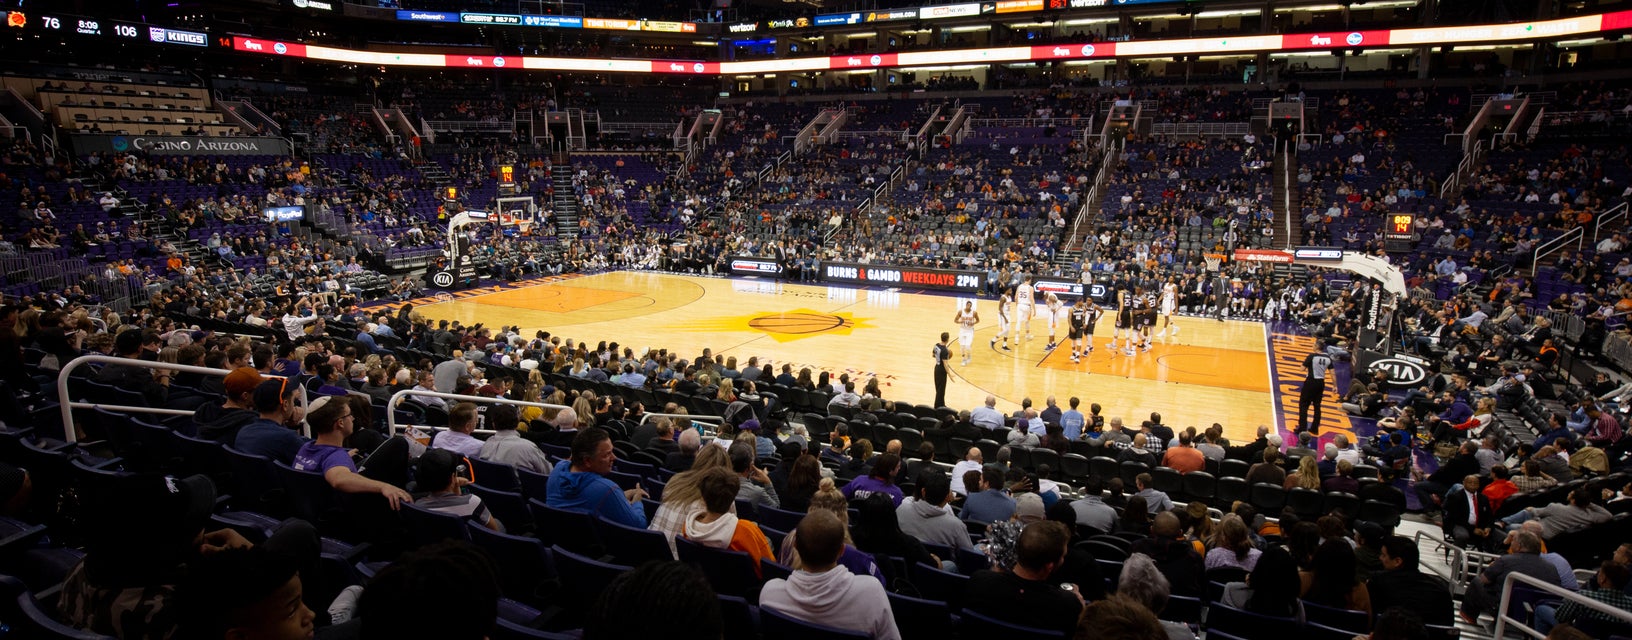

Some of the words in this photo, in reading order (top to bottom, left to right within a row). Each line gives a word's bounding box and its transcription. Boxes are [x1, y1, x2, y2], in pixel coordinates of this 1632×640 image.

[42, 16, 60, 29] 76
[78, 20, 98, 29] 8:09
[114, 25, 137, 37] 106
[729, 23, 755, 33] verizon
[167, 31, 204, 44] KINGS
[219, 37, 230, 47] 14
[133, 137, 191, 151] CSINO
[196, 138, 259, 151] ARIZONA
[503, 173, 512, 182] 14
[278, 210, 303, 219] PayPal
[1396, 224, 1407, 232] 14
[436, 274, 450, 284] KIA
[827, 266, 858, 279] BURNS
[858, 269, 867, 280] &
[867, 268, 900, 283] GAMBO
[902, 271, 955, 287] WEEKDAYS
[956, 274, 979, 288] 2PM
[1367, 289, 1380, 330] Southwest
